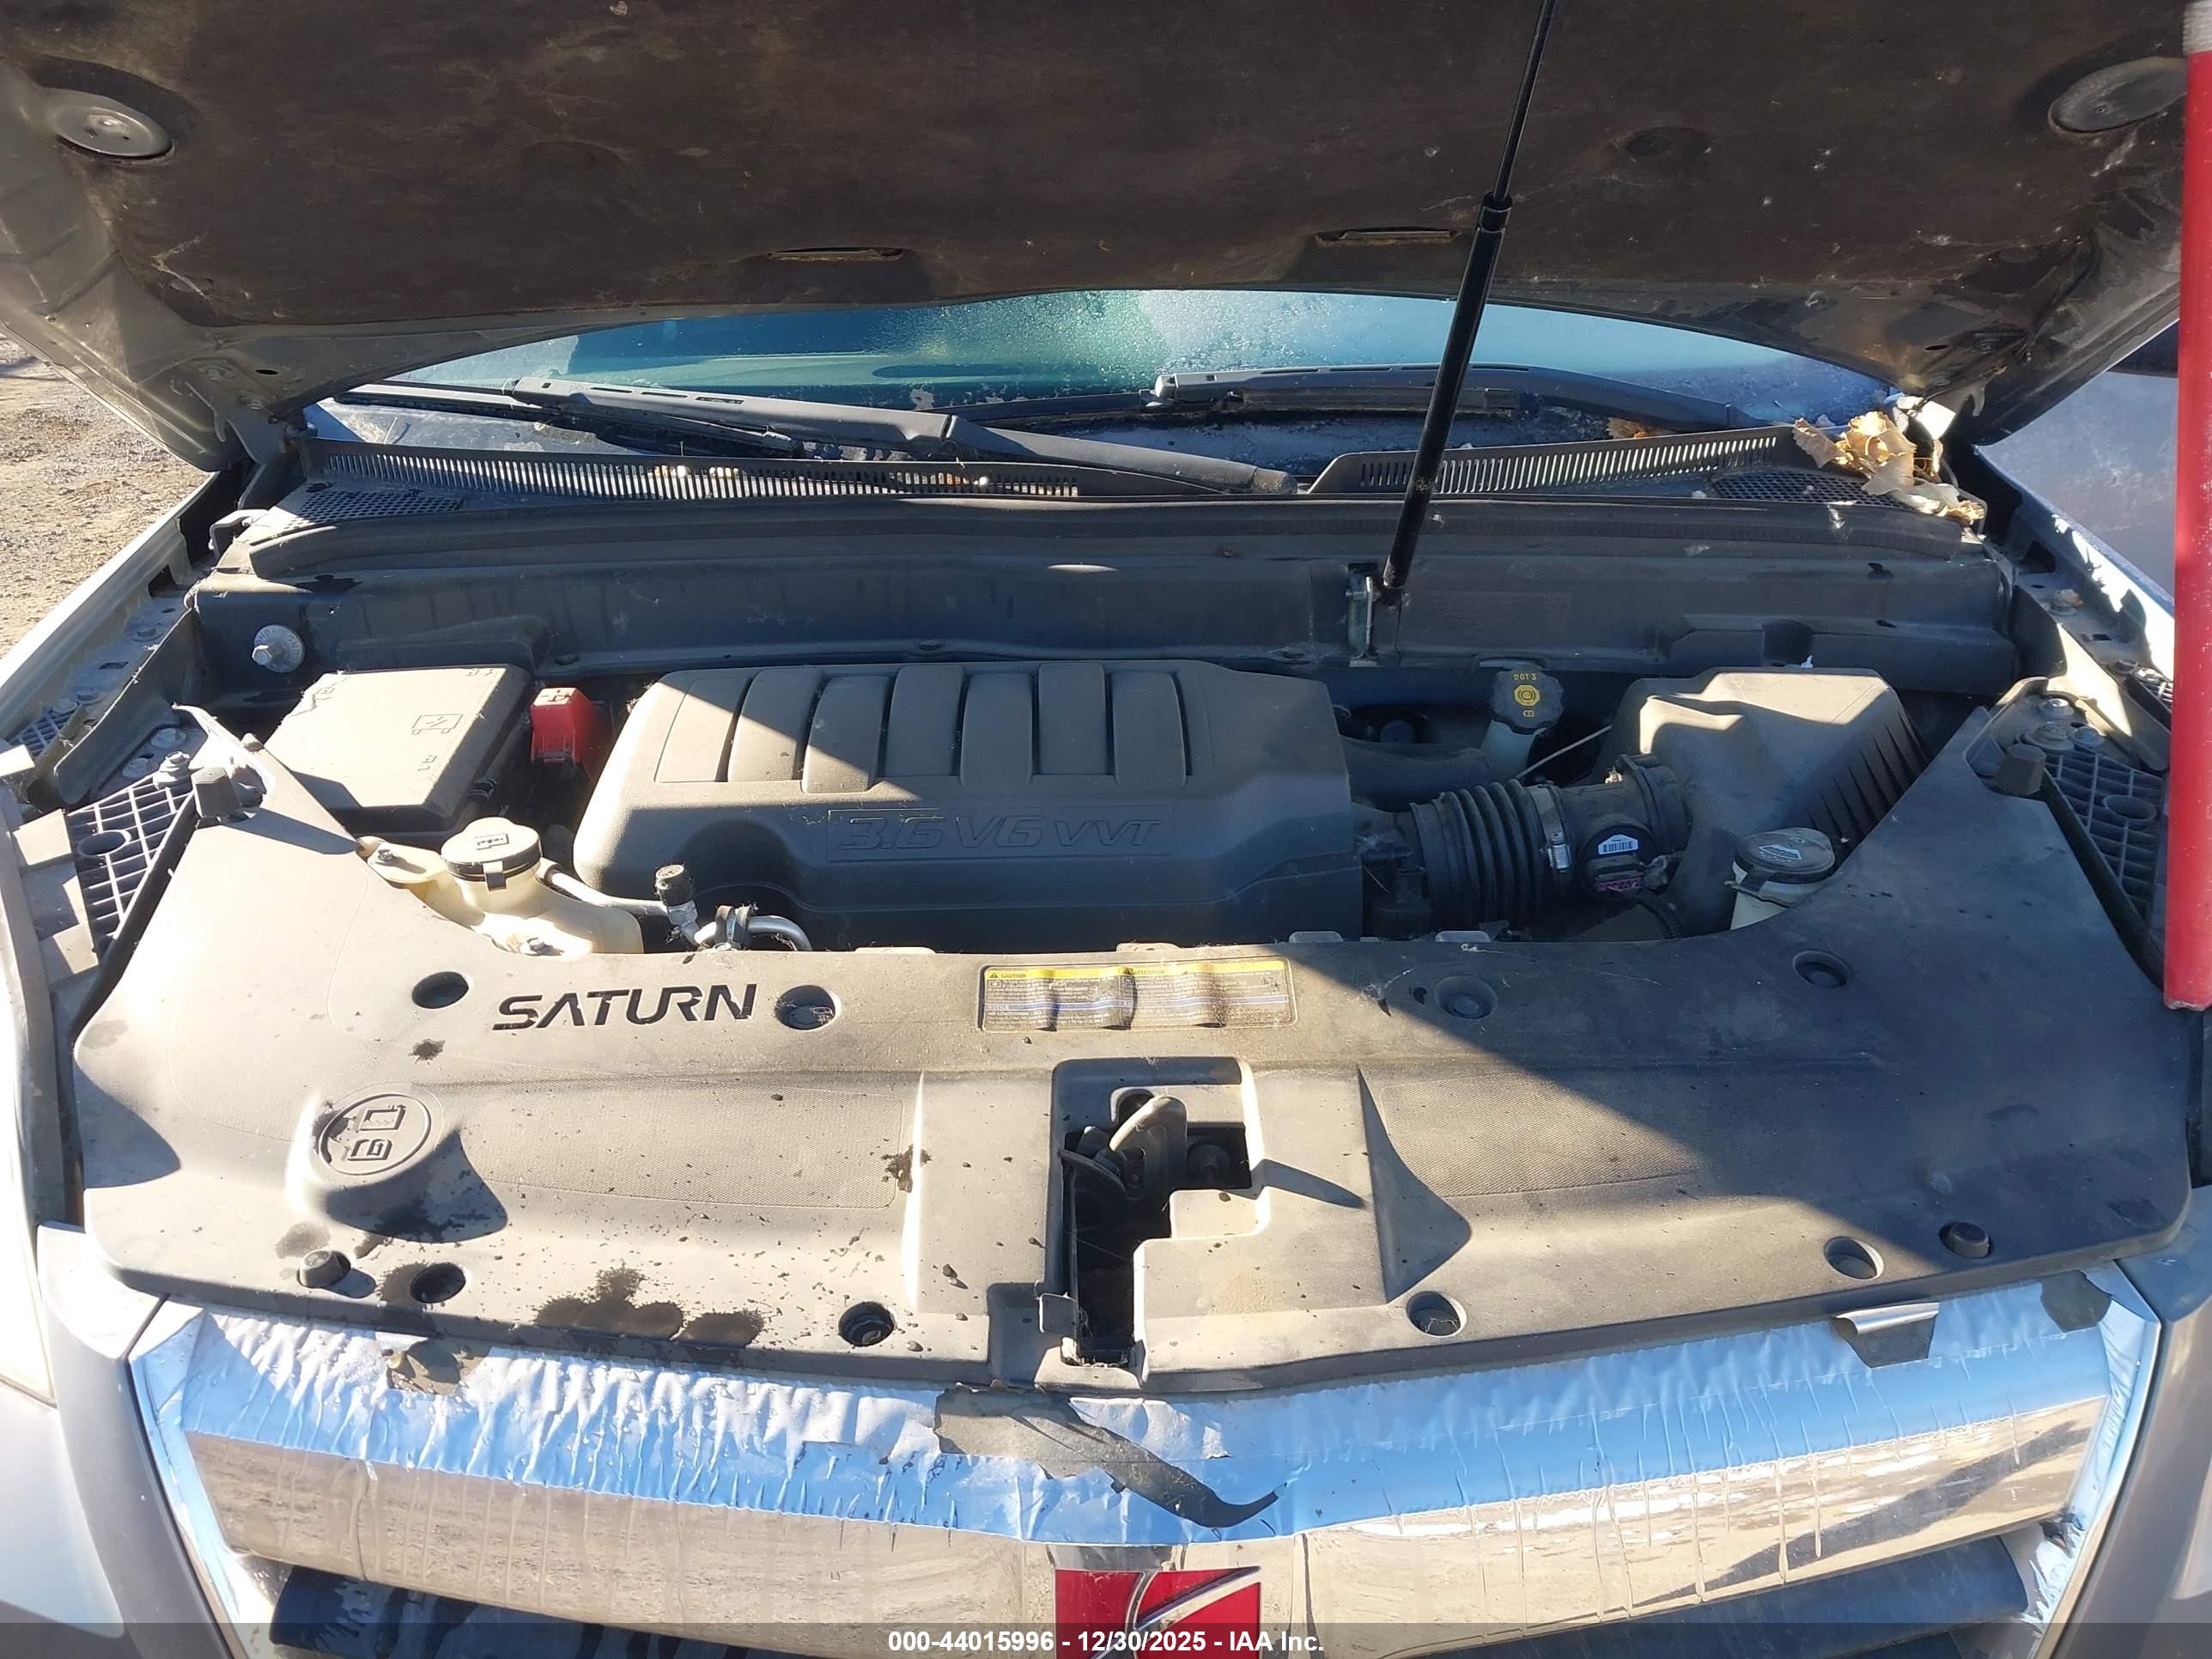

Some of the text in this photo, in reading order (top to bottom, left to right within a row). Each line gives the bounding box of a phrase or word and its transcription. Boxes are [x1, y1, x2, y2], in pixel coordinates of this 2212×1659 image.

[838, 815, 1163, 850] 3.6 V6 VVT
[491, 983, 757, 1031] SATURN
